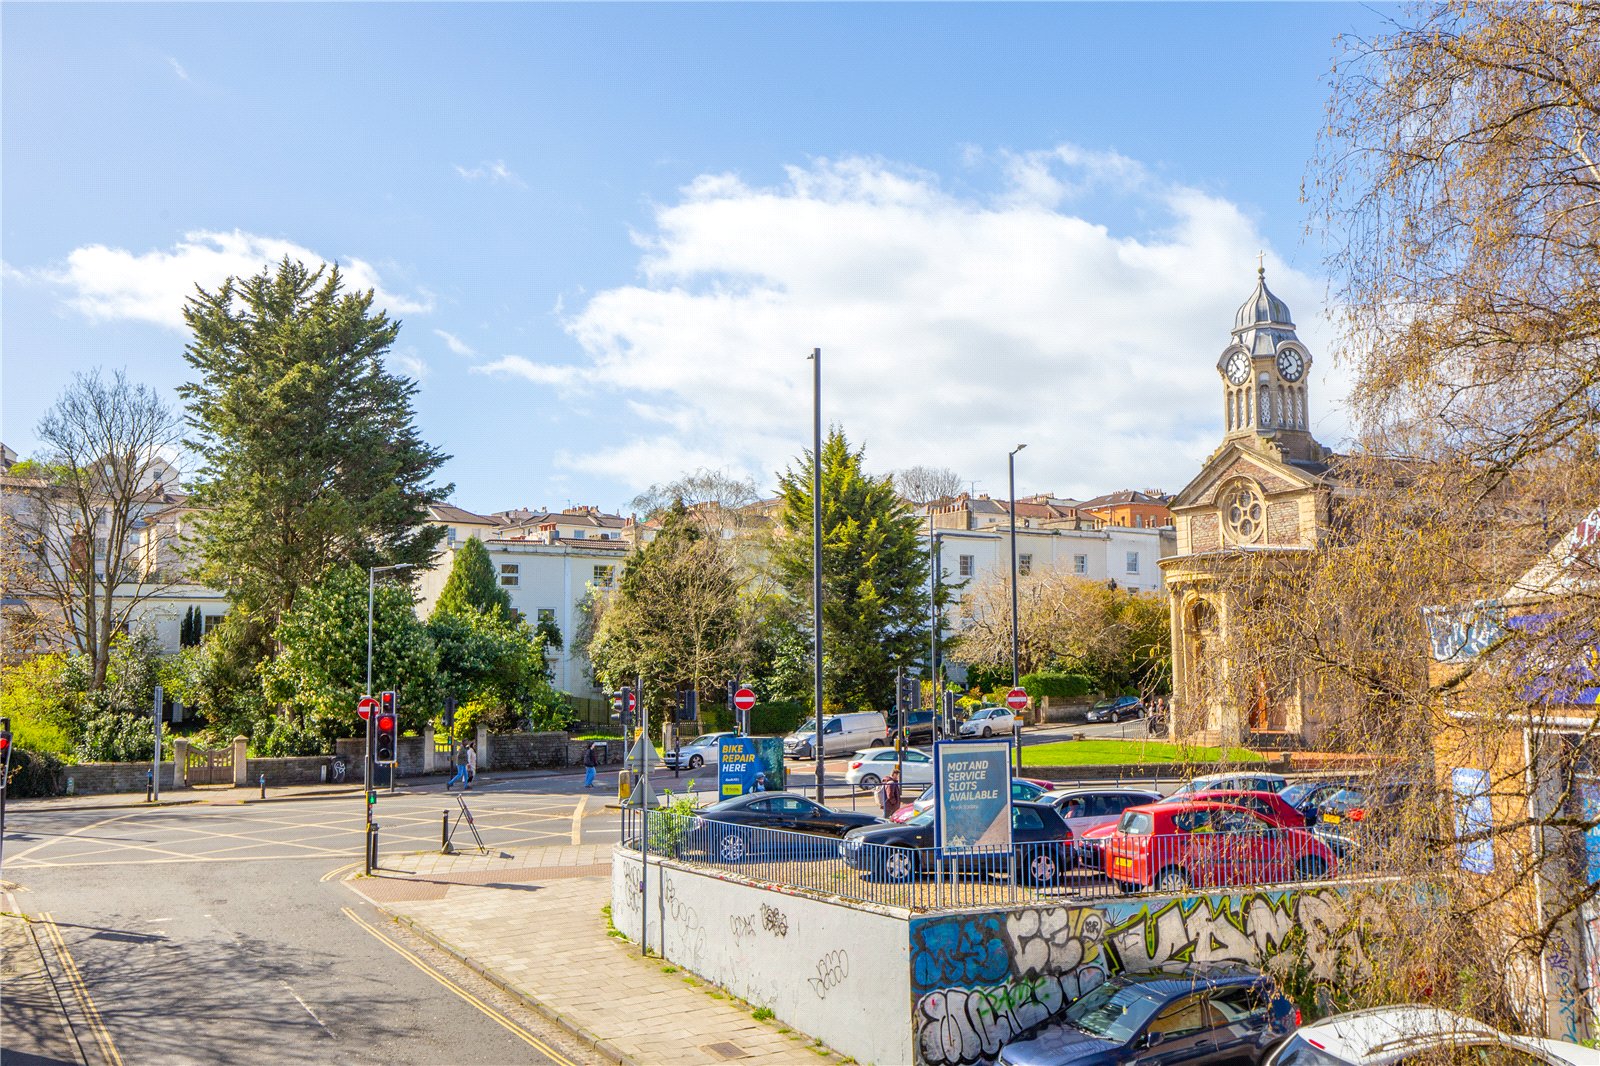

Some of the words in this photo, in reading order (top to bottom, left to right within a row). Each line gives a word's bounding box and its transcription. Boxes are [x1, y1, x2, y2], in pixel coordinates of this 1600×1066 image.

[722, 744, 744, 754] BIKE
[722, 754, 755, 763] REPAIR
[722, 763, 747, 772] HERE
[947, 761, 968, 772] MOT
[968, 760, 989, 771] AND
[947, 770, 987, 782] SERVICE
[948, 781, 978, 792] SLOTS
[949, 789, 999, 802] AVAILABLE
